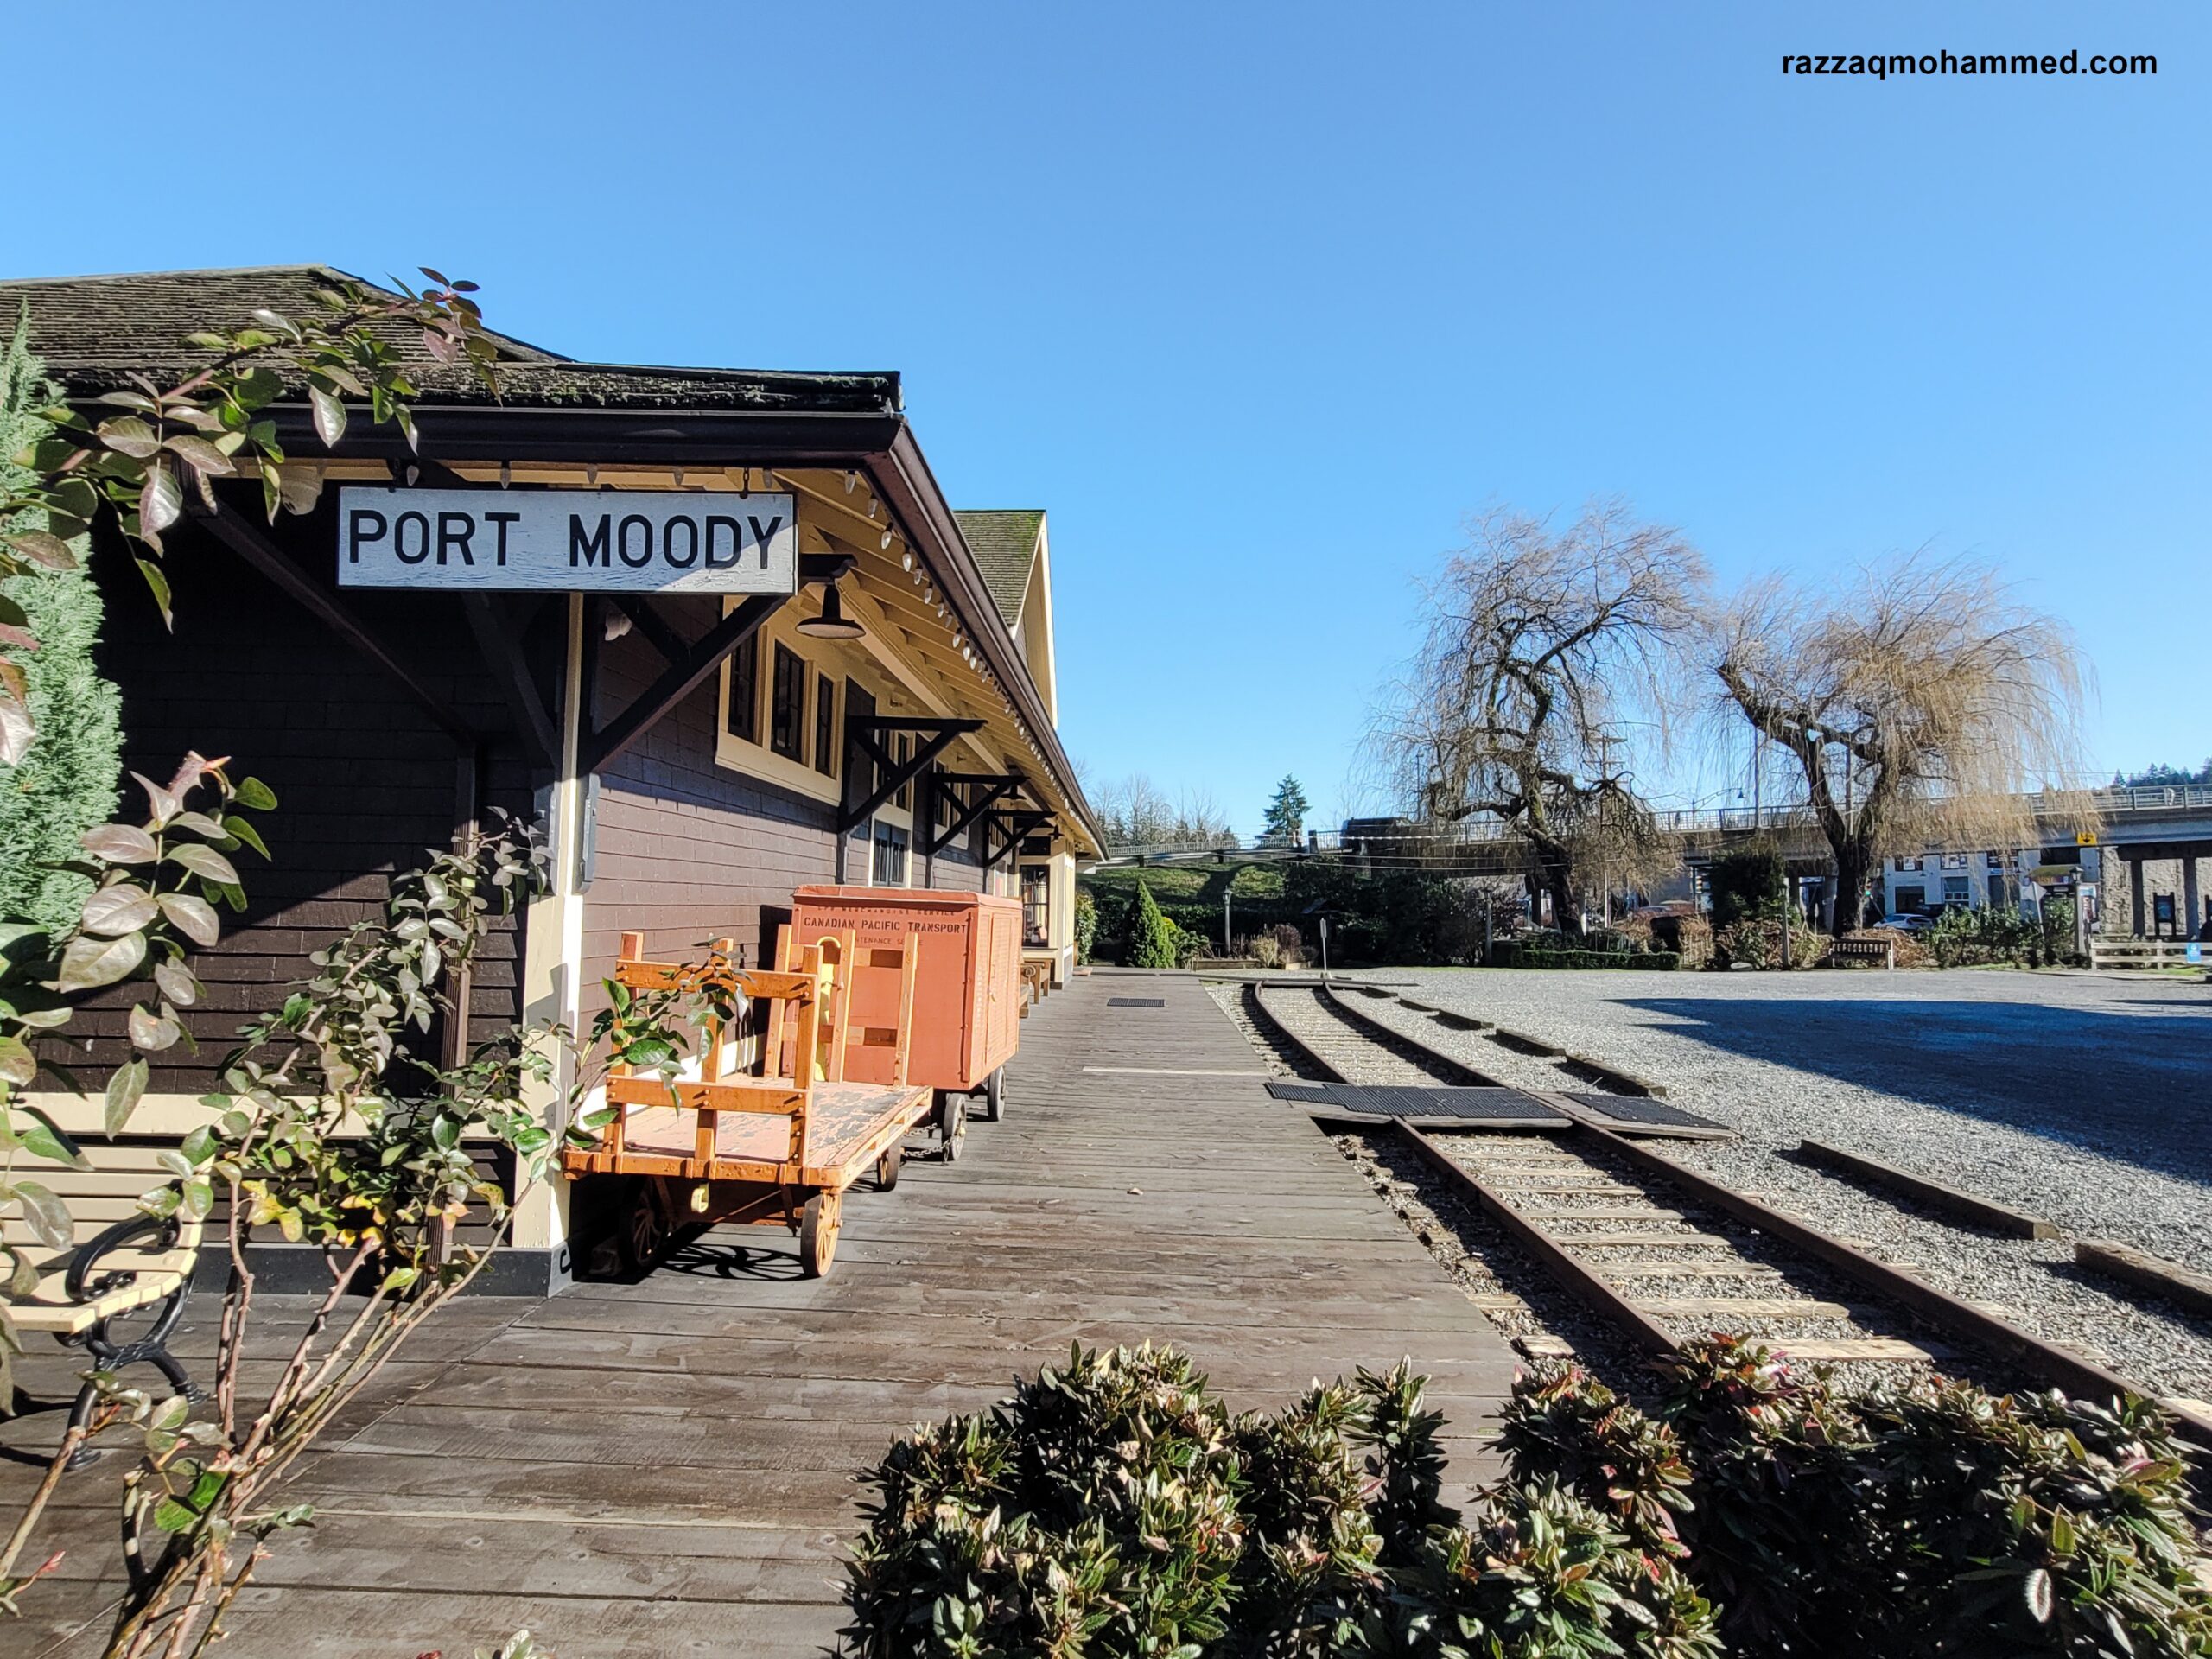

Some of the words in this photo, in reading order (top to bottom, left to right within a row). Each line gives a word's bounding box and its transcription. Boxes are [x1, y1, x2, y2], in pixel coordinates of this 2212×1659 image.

[349, 509, 521, 566] PORT
[569, 513, 783, 570] MOODY
[804, 917, 855, 929] CANADIAN
[861, 919, 900, 931] PACIFIC
[908, 921, 966, 933] TRANSPORT
